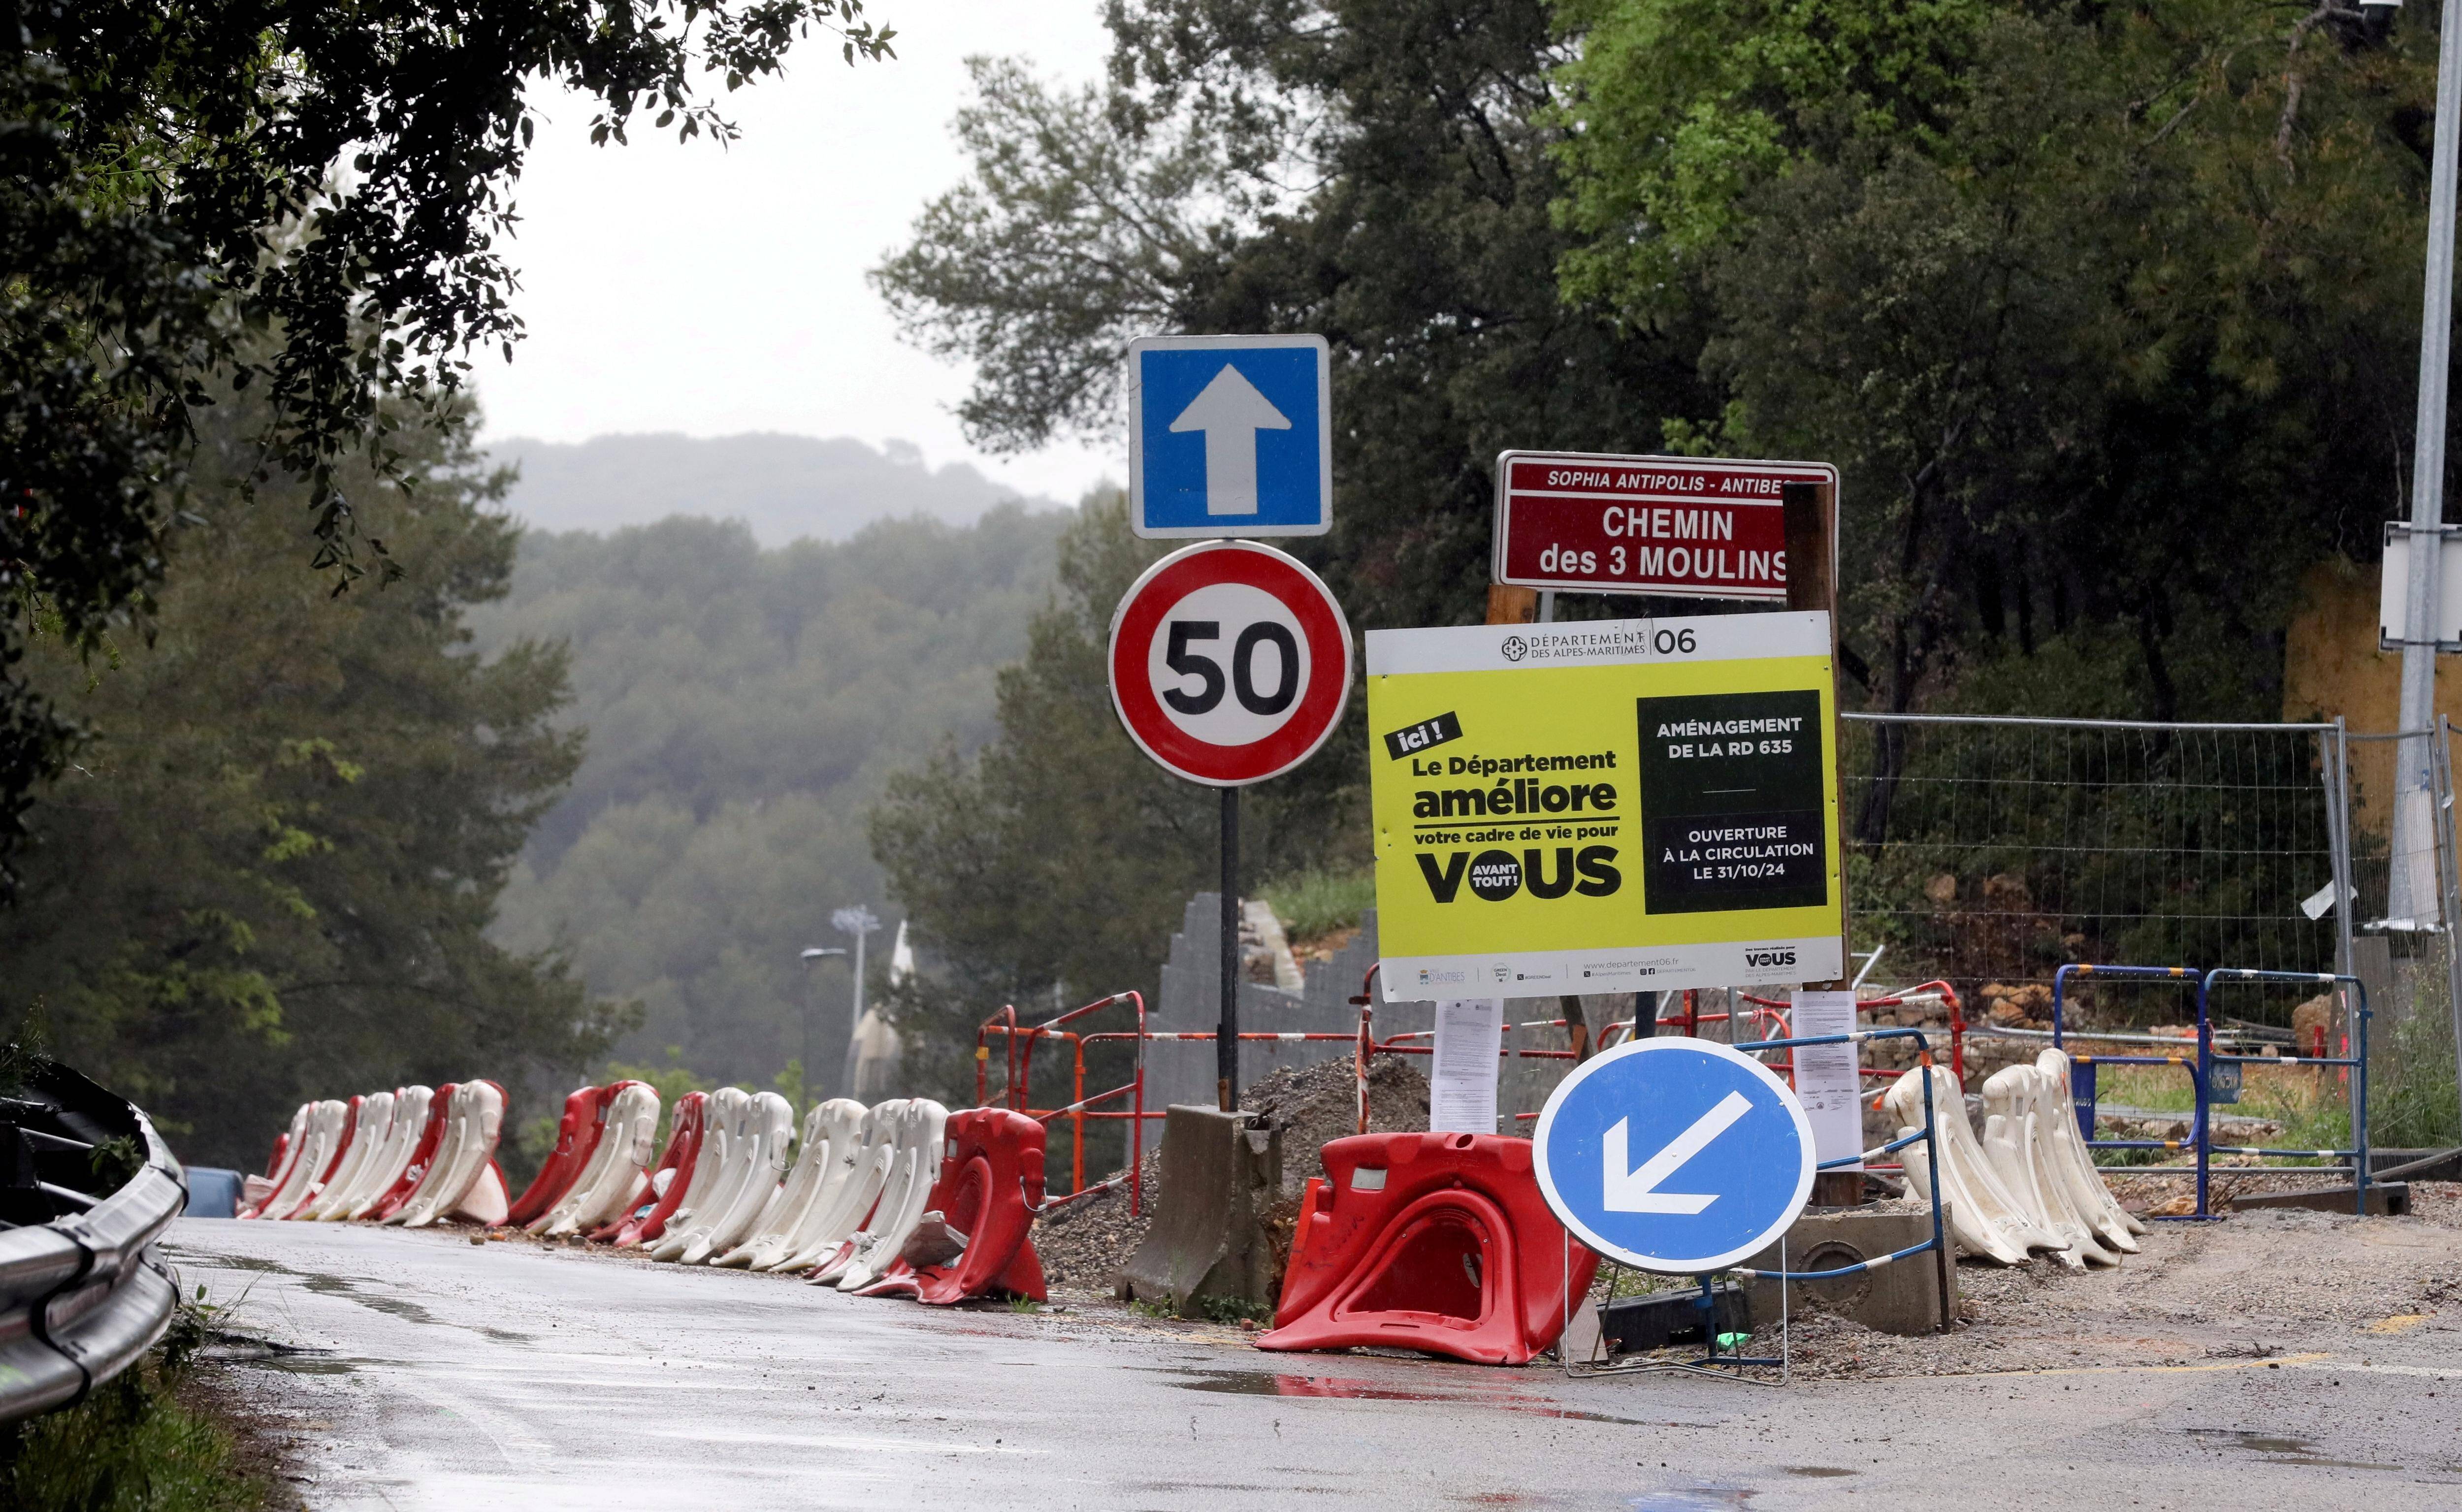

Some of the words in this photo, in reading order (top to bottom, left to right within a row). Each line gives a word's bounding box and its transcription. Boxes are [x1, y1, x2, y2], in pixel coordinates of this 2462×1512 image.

[1548, 471, 1610, 488] SOPHIA
[1616, 474, 1704, 491] ANTIPOLIS
[1720, 478, 1791, 494] ANTIBE
[1603, 506, 1733, 541] CHEMIN
[1540, 543, 1597, 574] des
[1610, 546, 1626, 575] 3
[1531, 632, 1644, 647] DÉPARTEMENT
[1654, 628, 1696, 654] 06
[1532, 649, 1550, 658] DES
[1554, 645, 1645, 657] ALPES-MARITIMES
[1163, 621, 1299, 715] 50
[1657, 717, 1802, 737] AMÉNAGEMENT
[1669, 744, 1693, 758] DE
[1699, 743, 1723, 757] LA
[1729, 741, 1753, 755] RD
[1759, 740, 1792, 754] 635
[1413, 758, 1442, 776] Le
[1449, 751, 1616, 777] Département
[1413, 778, 1617, 818] améliore
[1414, 832, 1461, 845] votre
[1465, 828, 1515, 843] cadre
[1520, 827, 1541, 840] de
[1546, 826, 1572, 839] vie
[1577, 825, 1619, 840] pour
[1689, 826, 1787, 842] OUVERTURE
[1663, 848, 1675, 862] À
[1680, 849, 1700, 862] LA
[1706, 843, 1814, 860] CIRCULATION
[1415, 845, 1622, 903] VOUS
[1472, 864, 1518, 875] AVANT
[1694, 868, 1712, 879] LE
[1717, 863, 1784, 879] 31/10/24
[1584, 958, 1679, 969] www.departement06.fr
[1746, 952, 1796, 967] VOUS
[1429, 971, 1465, 982] D'ANTIBES
